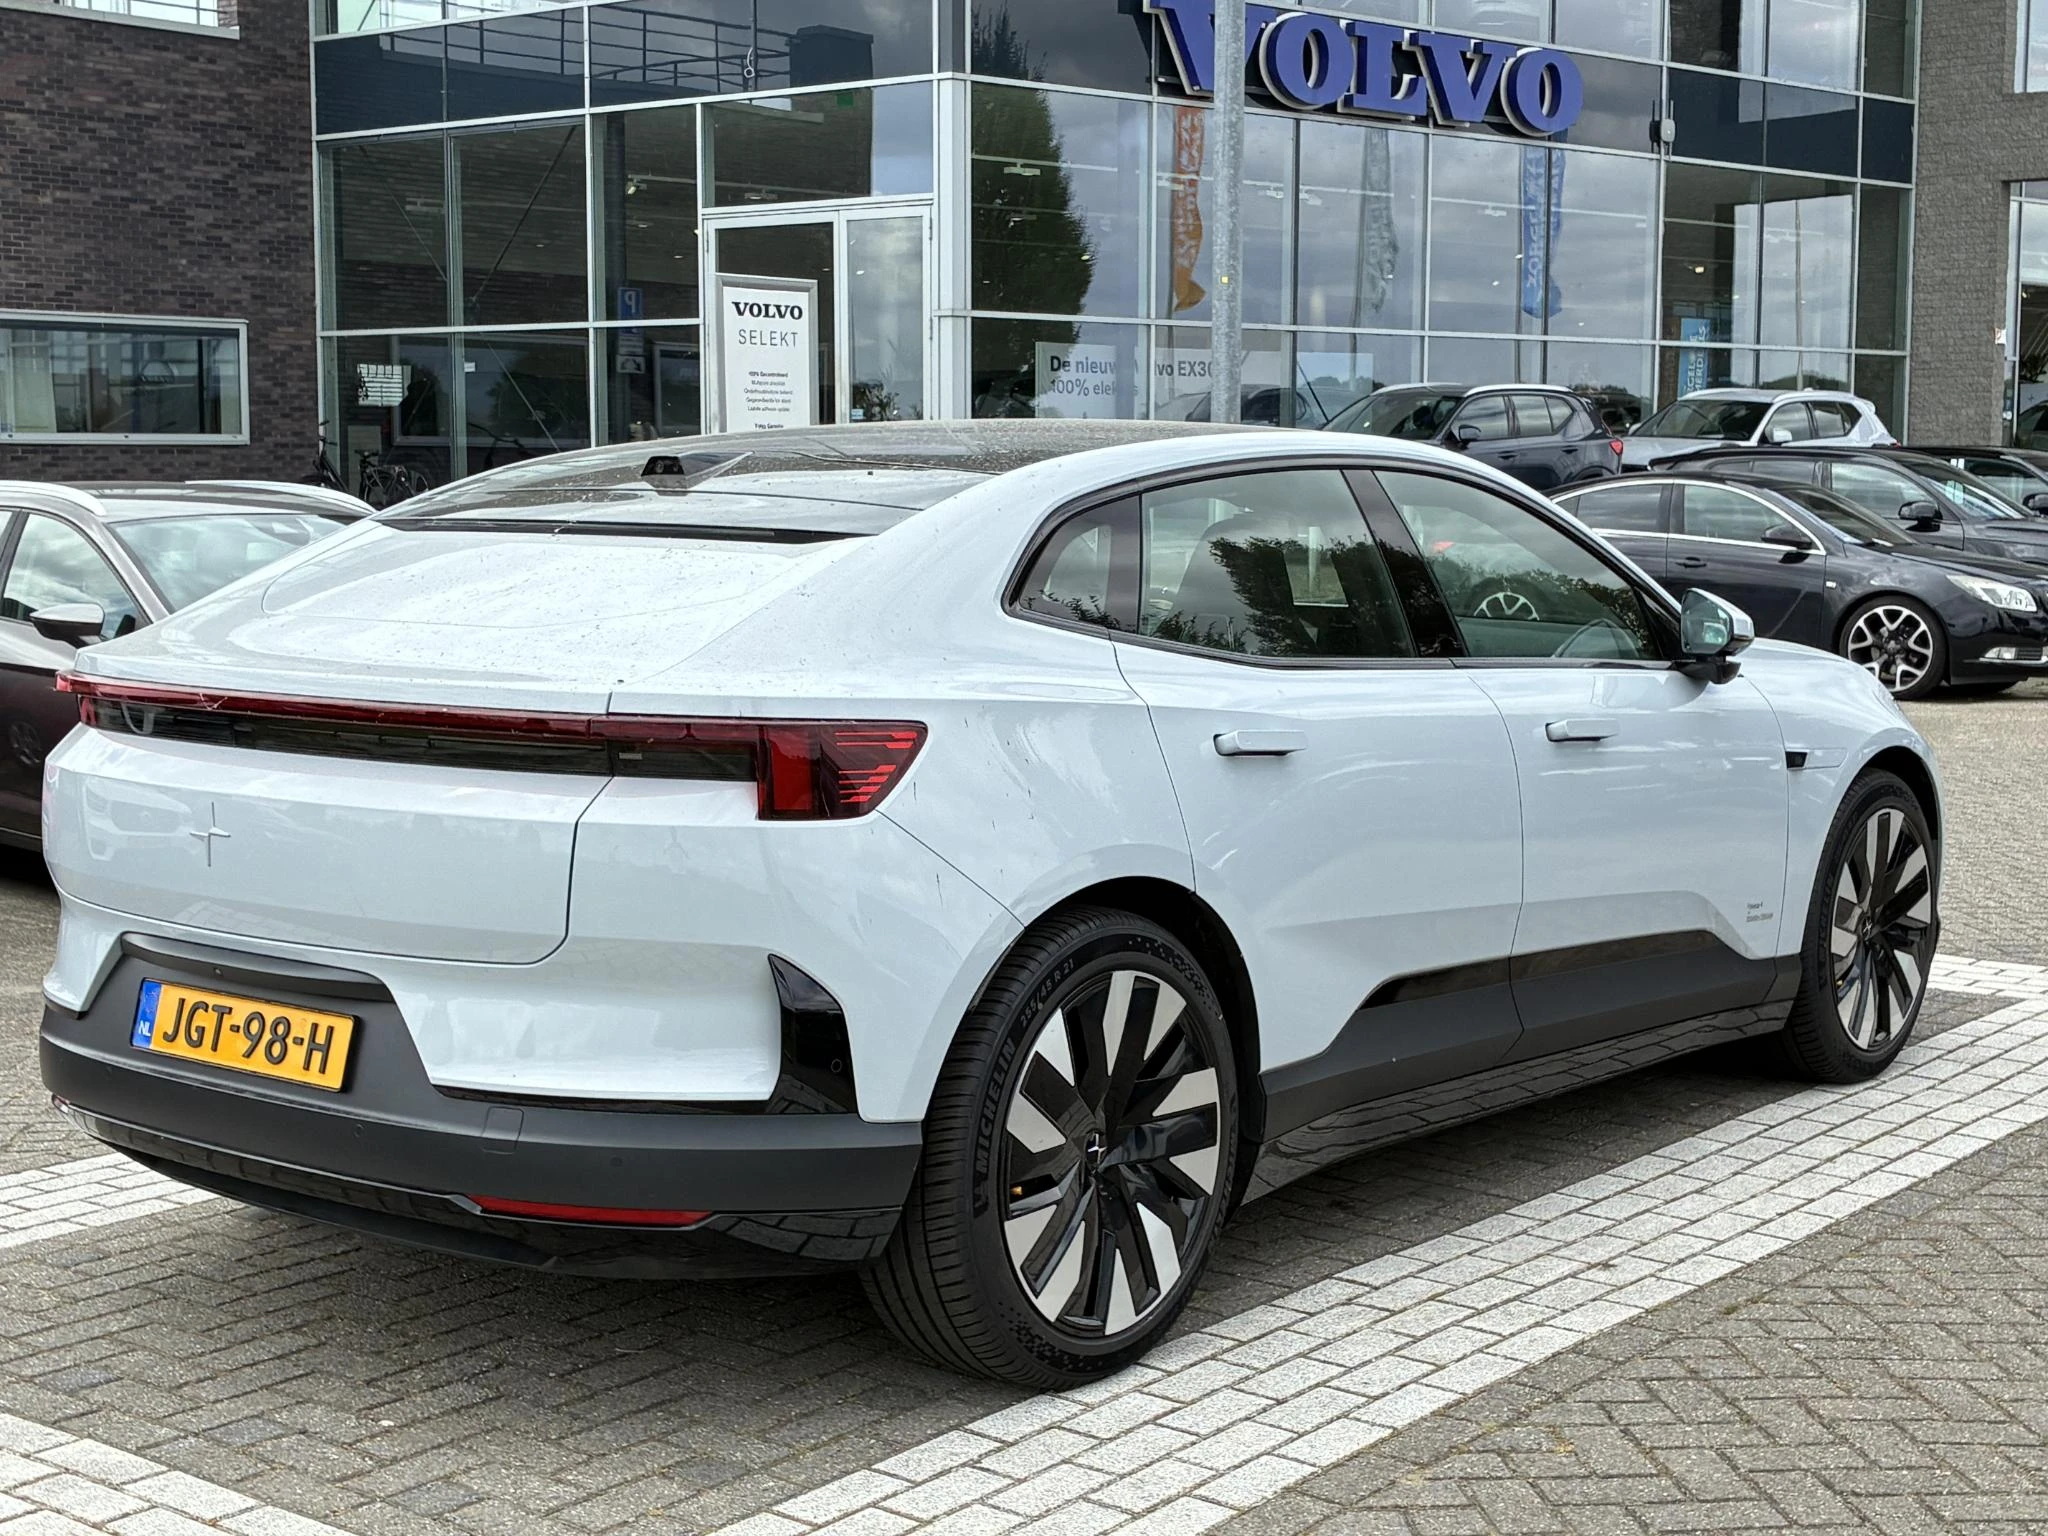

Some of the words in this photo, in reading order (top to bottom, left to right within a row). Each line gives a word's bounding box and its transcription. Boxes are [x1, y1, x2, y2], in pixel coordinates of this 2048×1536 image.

[1146, 0, 1584, 137] VOLVO
[731, 301, 803, 320] VOLVO
[738, 328, 799, 348] SELEKT
[1050, 355, 1071, 373] De
[1050, 378, 1090, 397] 100%
[138, 1019, 151, 1036] NL
[162, 997, 335, 1075] JGT-98-H
[976, 1036, 1016, 1175] MICHELIN
